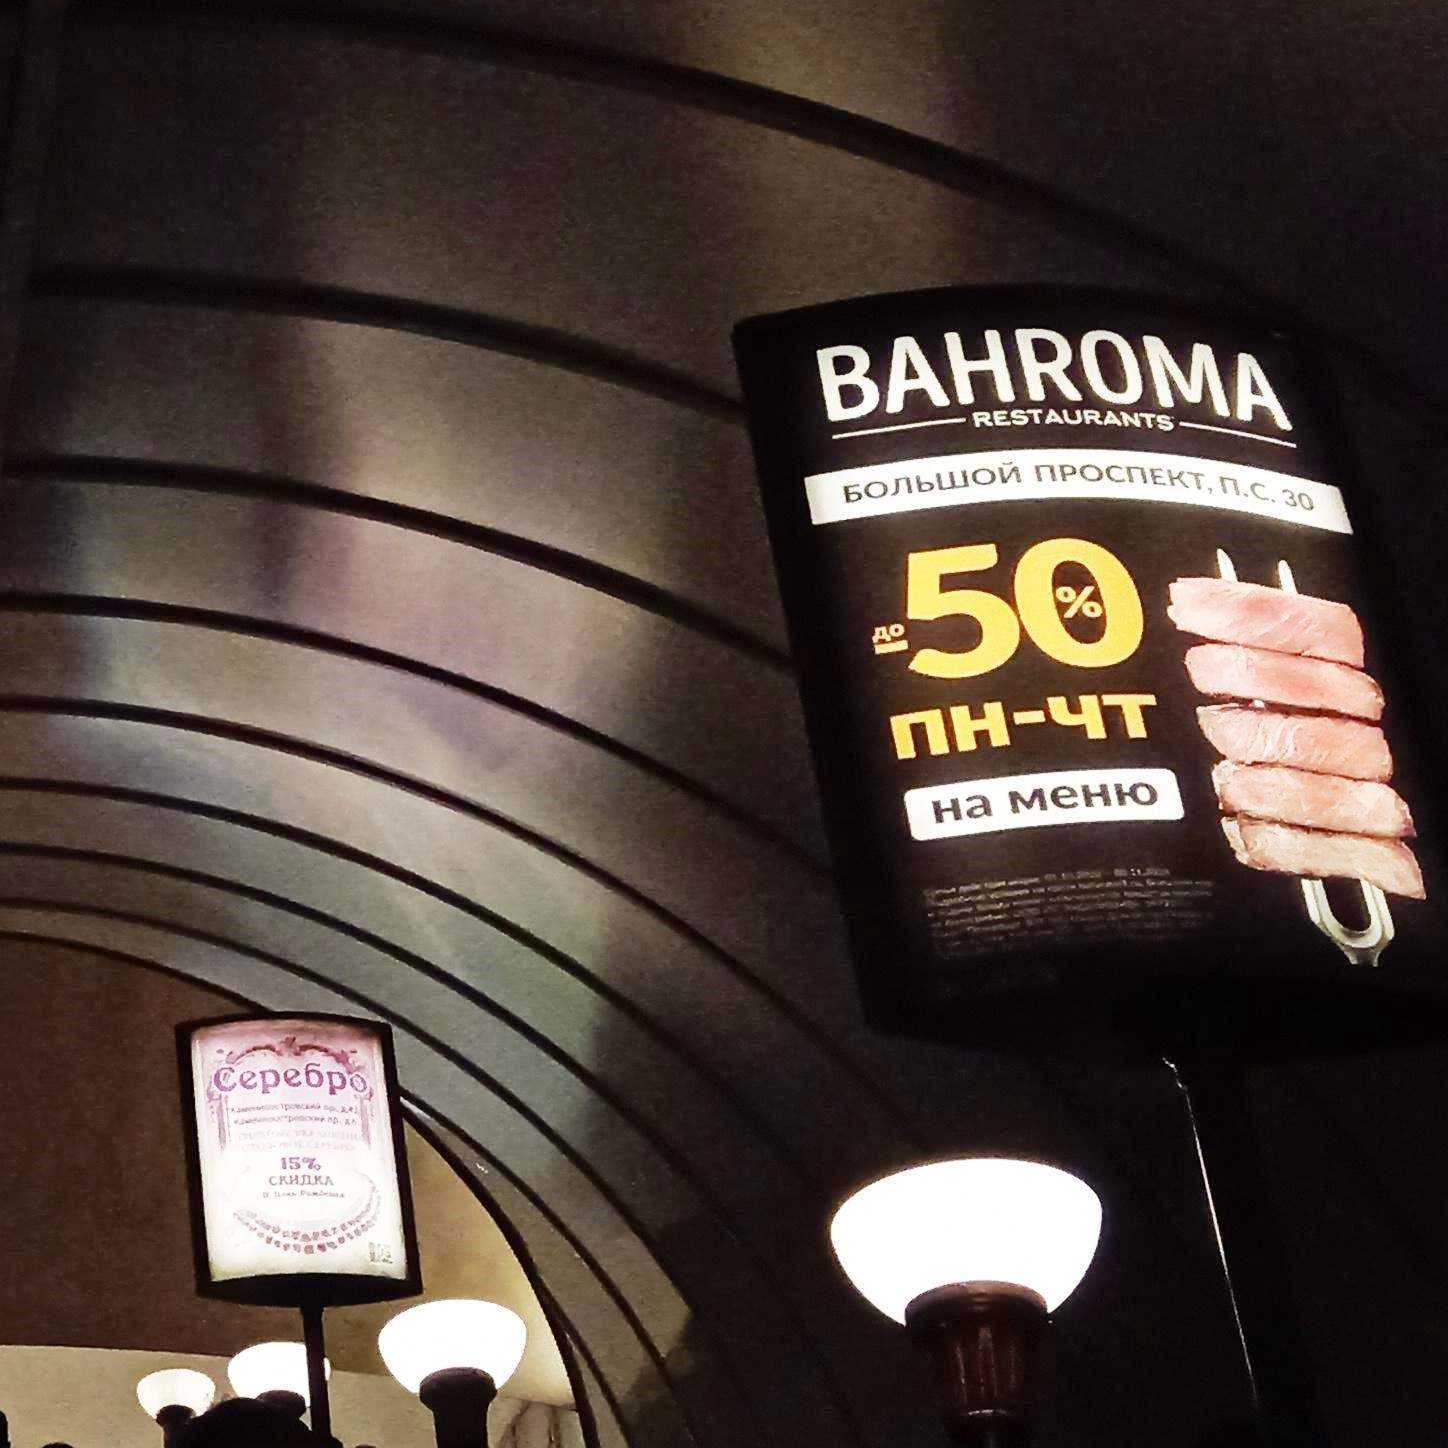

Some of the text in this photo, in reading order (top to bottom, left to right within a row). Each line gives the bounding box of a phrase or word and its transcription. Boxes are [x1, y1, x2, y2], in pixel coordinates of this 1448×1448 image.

[816, 328, 1293, 431] BAHROMA
[972, 408, 1176, 431] RESTAURANTS
[843, 463, 1315, 512] БОЛЬШОЙ ПРОСПЕКТ, П.С. 30
[872, 622, 906, 644] до
[931, 782, 1159, 824] на меню
[213, 1063, 368, 1095] Серебро
[281, 1156, 321, 1171] 15%
[269, 1174, 334, 1186] СКИДКА
